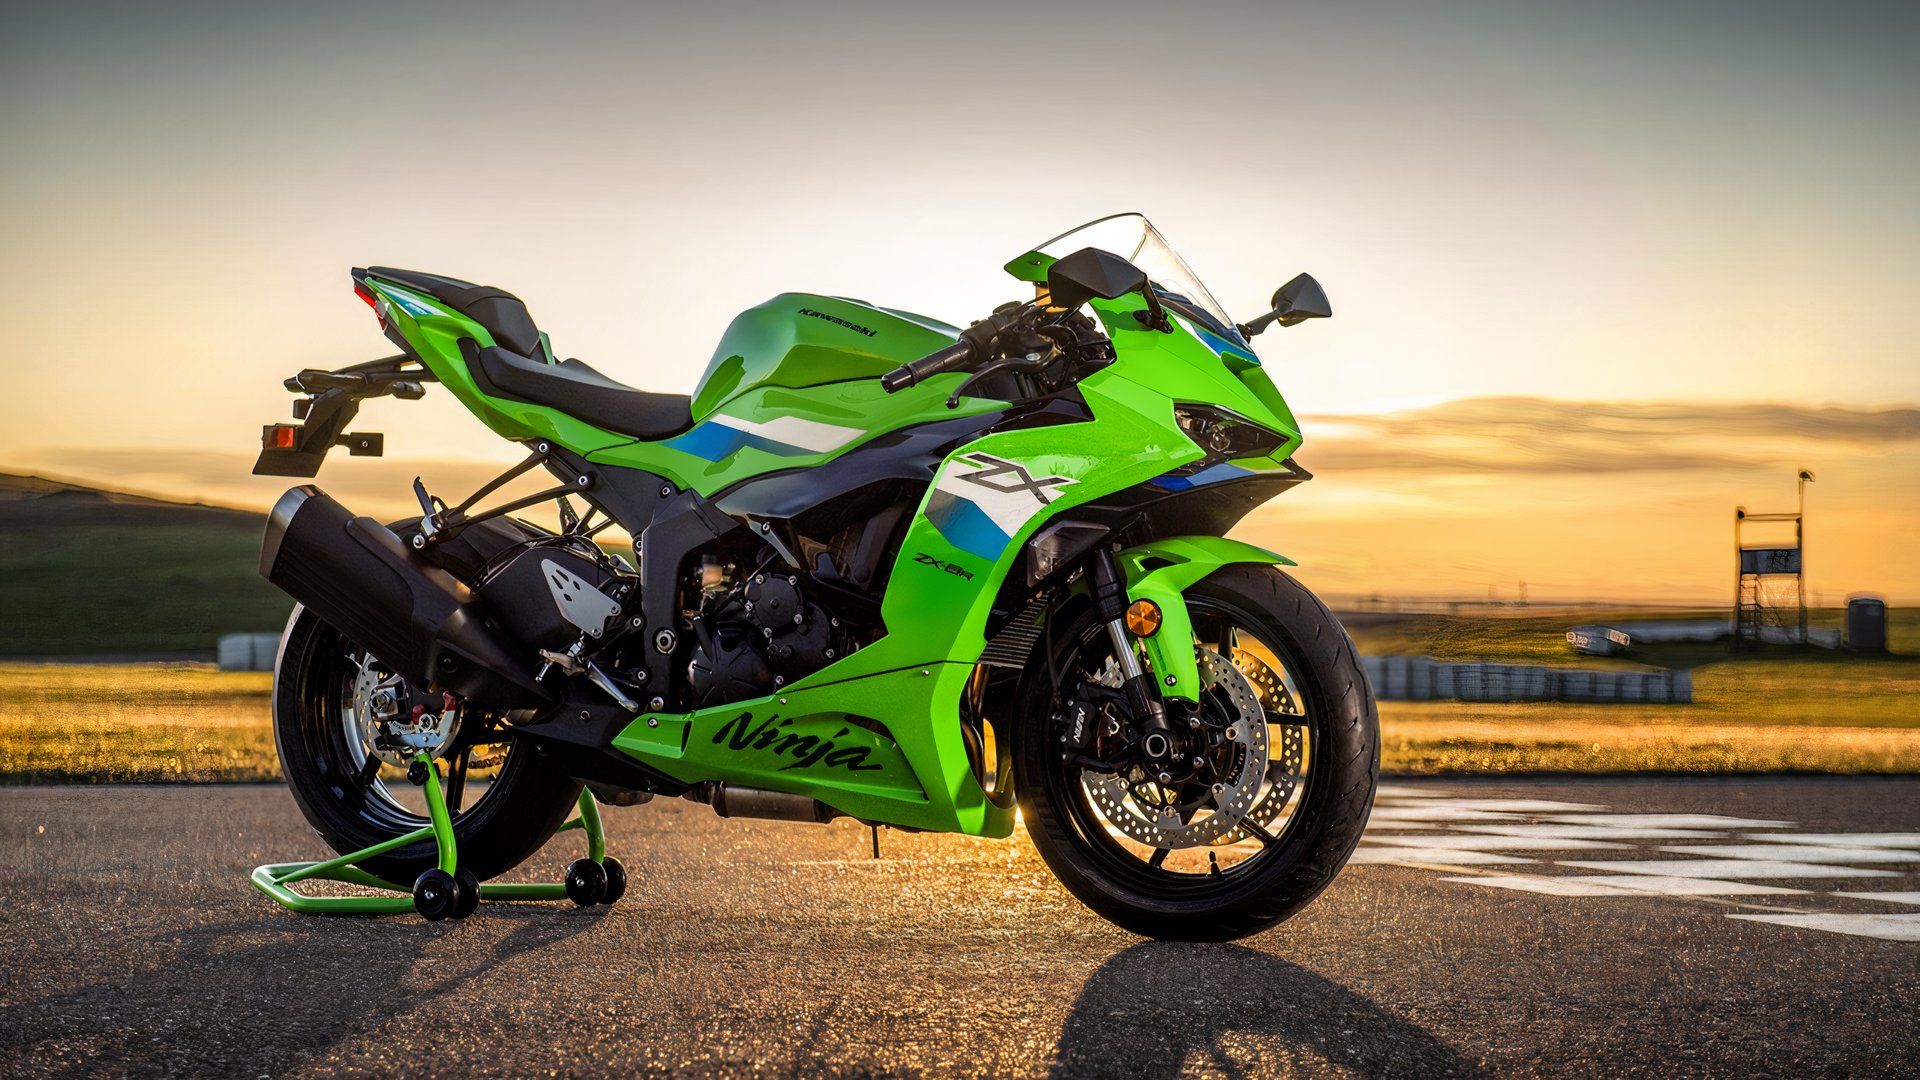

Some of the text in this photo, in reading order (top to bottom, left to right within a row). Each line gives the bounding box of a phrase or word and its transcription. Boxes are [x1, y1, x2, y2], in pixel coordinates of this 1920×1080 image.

[798, 308, 878, 337] Kawasaki
[954, 453, 1070, 505] ZX
[712, 711, 883, 771] Ninja
